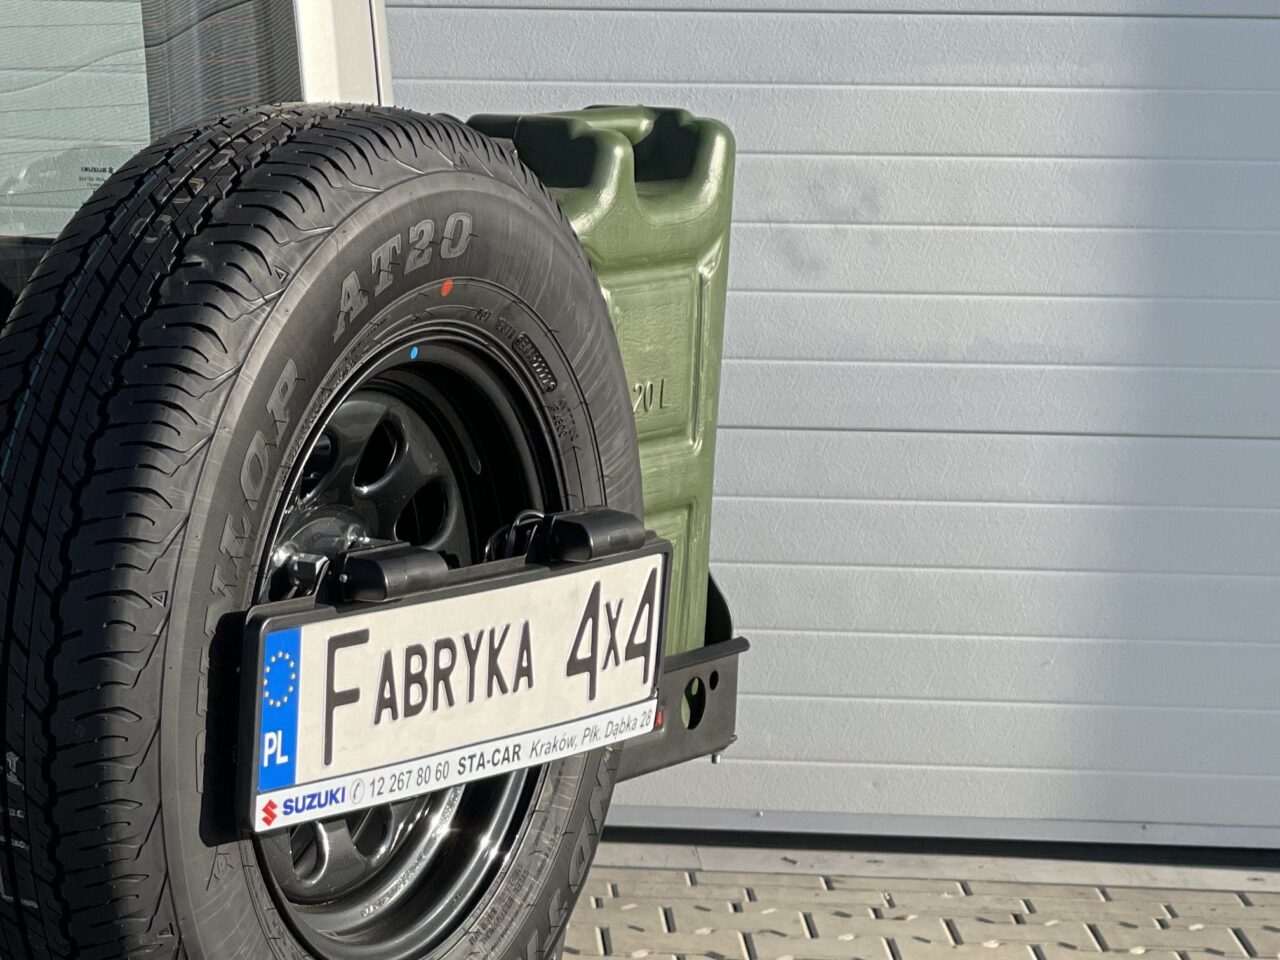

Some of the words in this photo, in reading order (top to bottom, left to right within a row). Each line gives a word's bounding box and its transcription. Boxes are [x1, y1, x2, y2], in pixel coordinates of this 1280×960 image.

[333, 211, 473, 345] AT20
[632, 380, 654, 413] 20
[659, 378, 671, 410] L
[322, 620, 535, 767] FABRYKA
[263, 730, 289, 768] PL
[282, 786, 346, 816] SUZUKI
[370, 776, 385, 798] 12
[389, 770, 412, 793] 267
[416, 764, 431, 786] 80
[435, 760, 450, 781] 60
[457, 743, 522, 775] STA-CAR
[529, 733, 578, 759] Kraków,
[604, 716, 638, 741] Dąbka
[639, 708, 653, 728] 28
